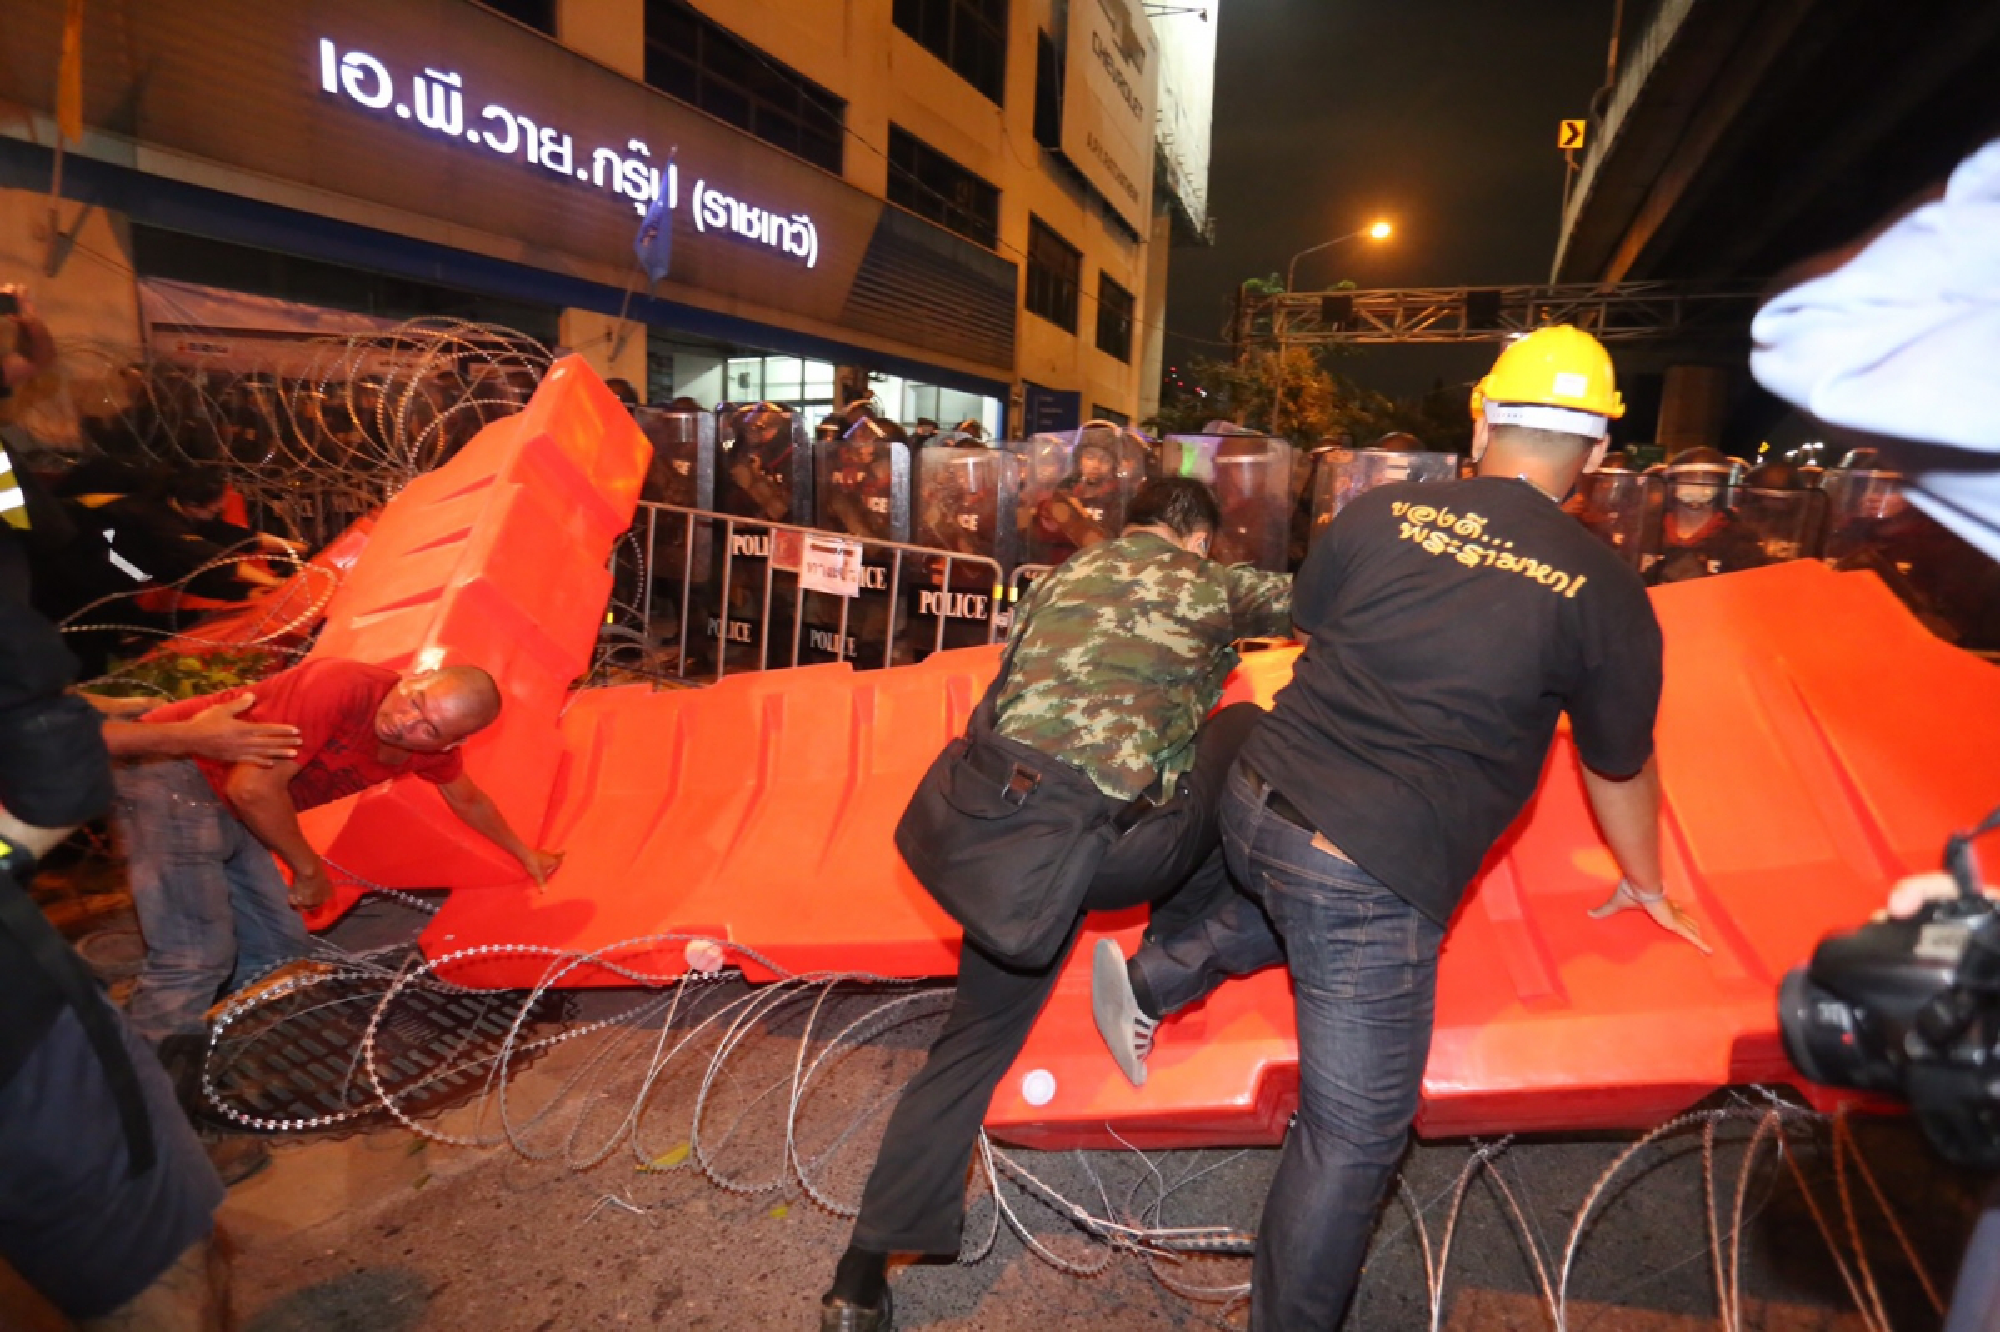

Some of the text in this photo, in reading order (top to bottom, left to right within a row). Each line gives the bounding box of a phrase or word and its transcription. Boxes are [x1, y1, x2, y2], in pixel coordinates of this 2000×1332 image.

[692, 179, 818, 269] (ราชเทวี)
[918, 589, 988, 620] POLICE
